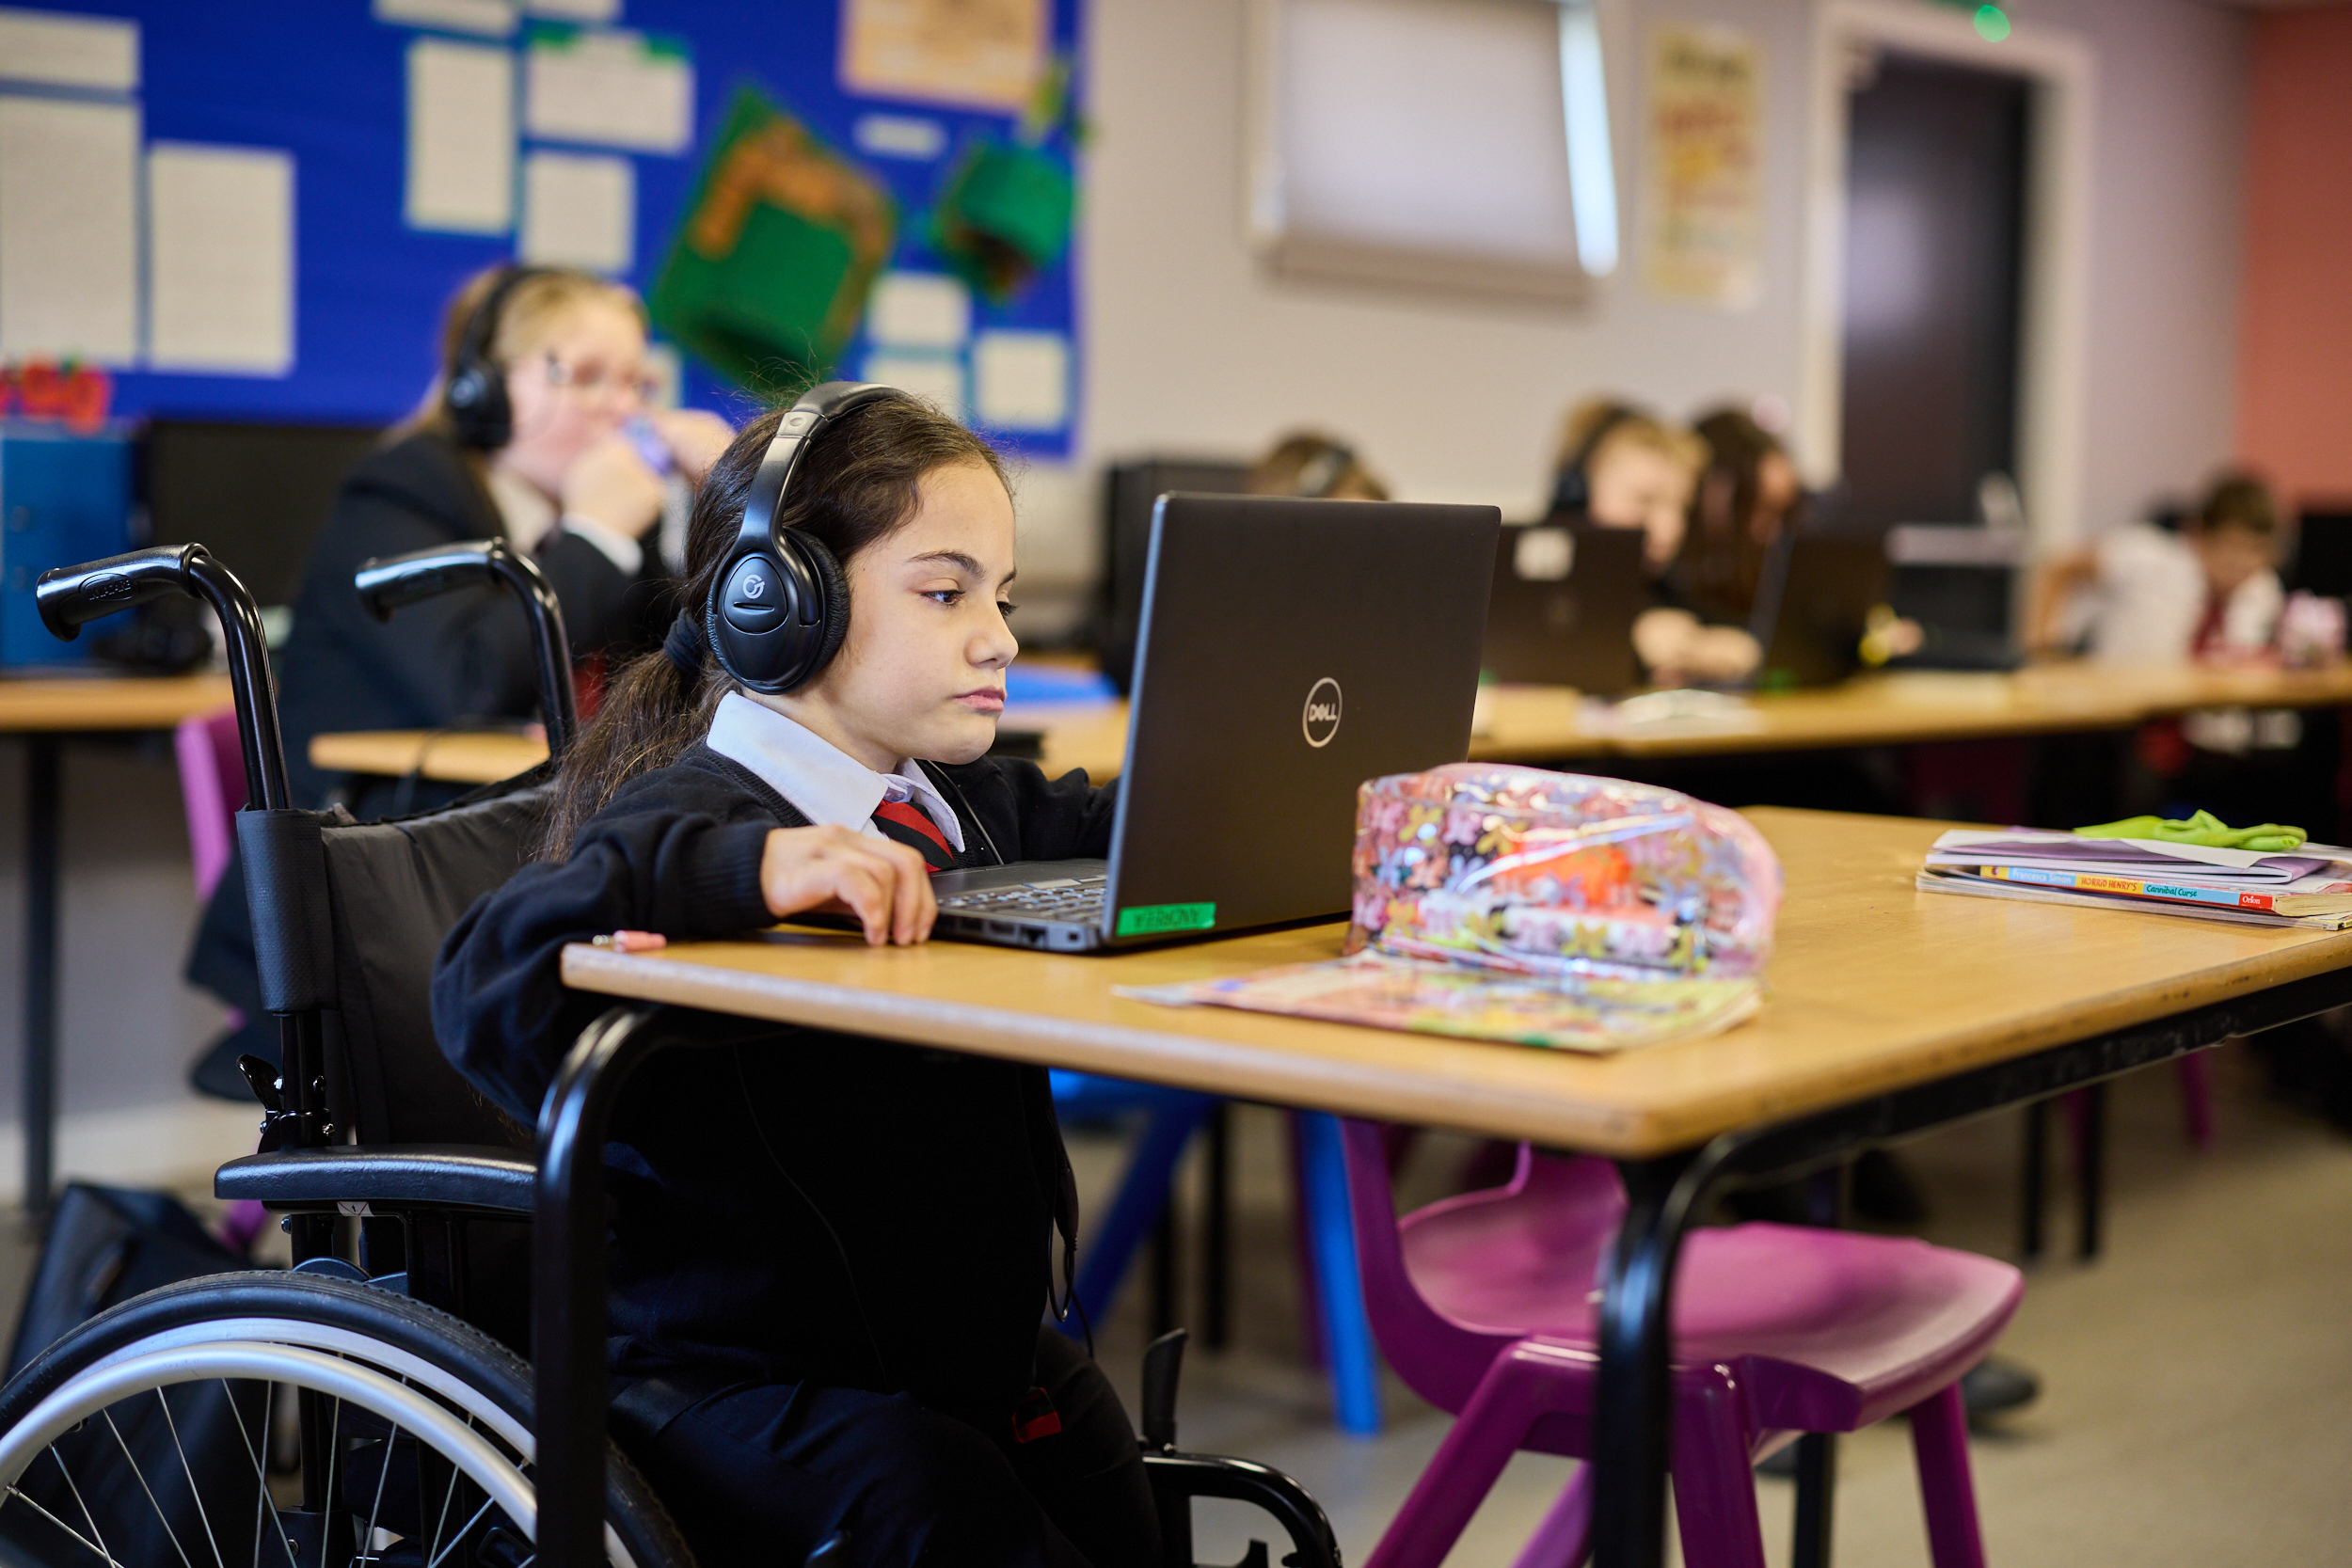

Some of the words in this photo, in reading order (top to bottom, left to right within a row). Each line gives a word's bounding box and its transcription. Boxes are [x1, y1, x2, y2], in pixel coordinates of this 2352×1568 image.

[1308, 703, 1338, 722] DELL
[2012, 869, 2047, 881] Francesca
[2049, 873, 2072, 884] Simon
[2108, 879, 2137, 892] HENRY'S
[2146, 885, 2177, 896] Cannibal
[2178, 889, 2198, 897] Curse
[2242, 895, 2261, 905] Orion
